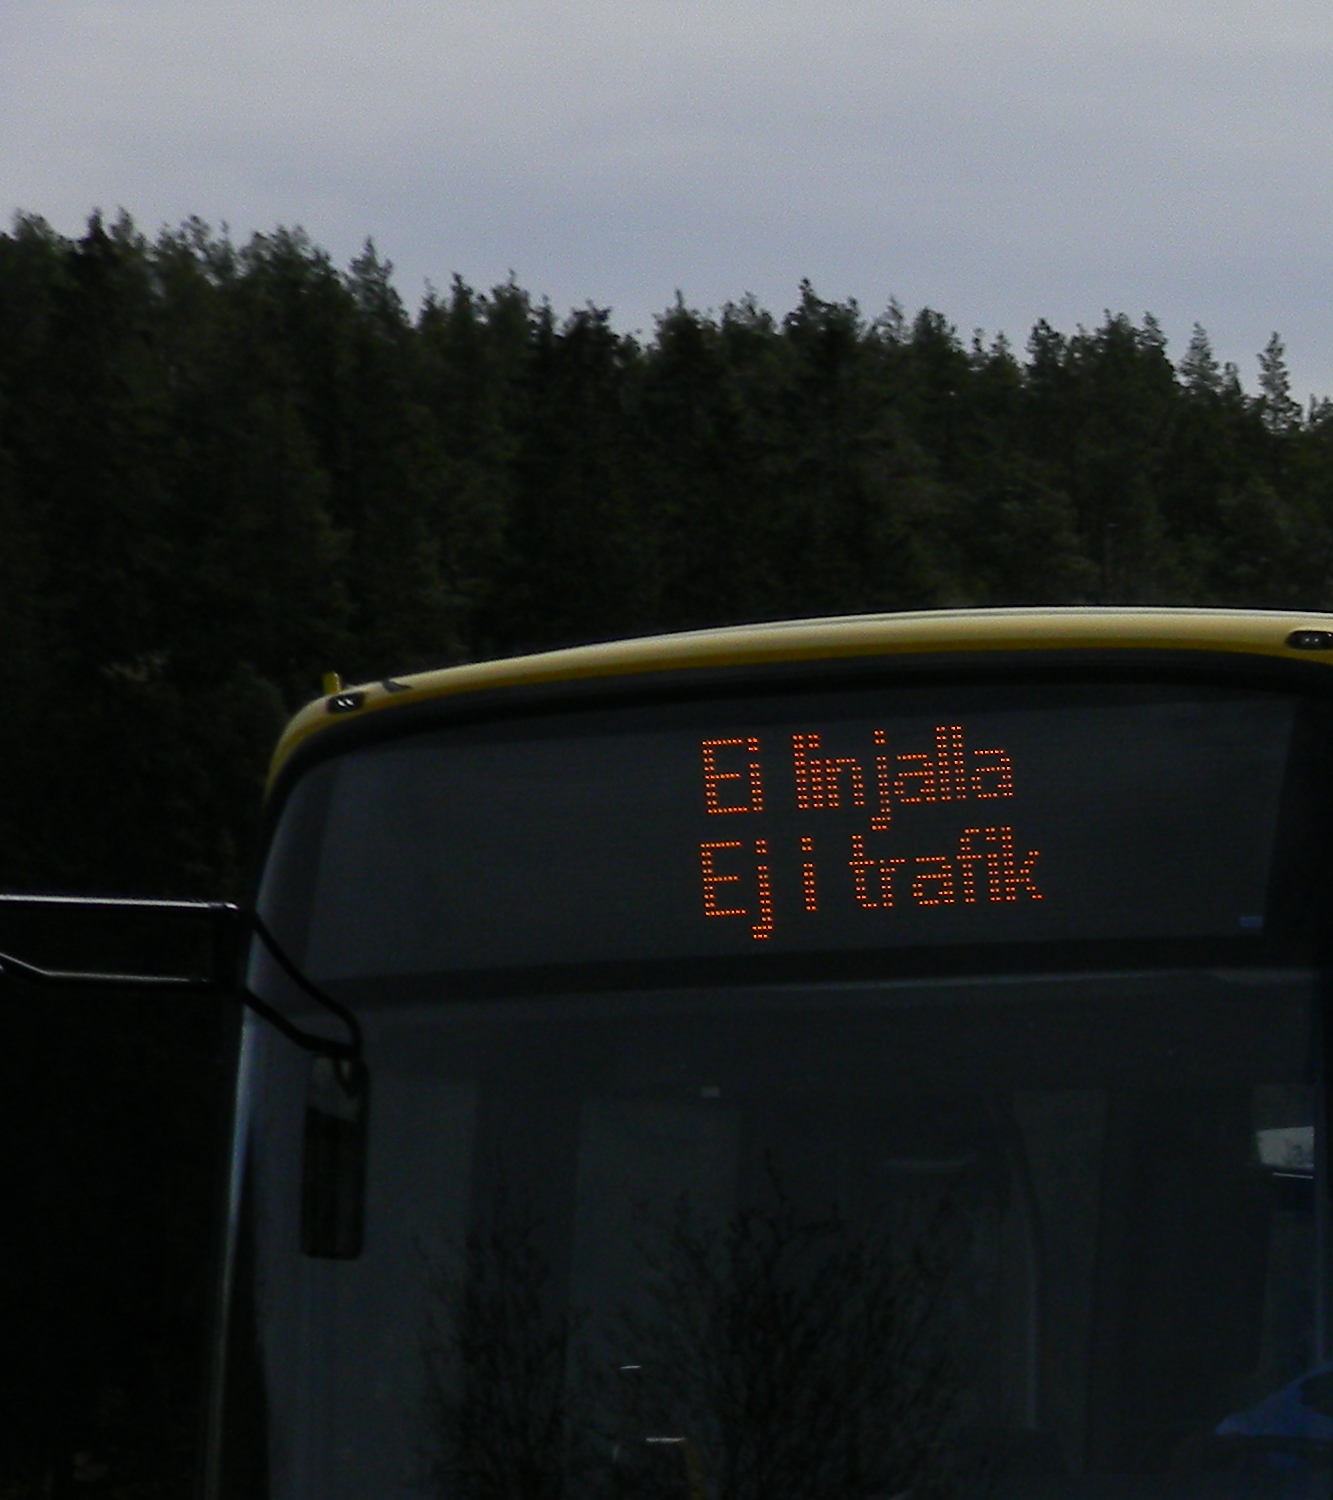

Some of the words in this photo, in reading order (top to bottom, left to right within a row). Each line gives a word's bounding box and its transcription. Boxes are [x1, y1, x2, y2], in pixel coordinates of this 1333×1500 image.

[701, 736, 763, 815] Ei
[791, 724, 1013, 831] linjalla
[699, 838, 773, 940] Ej
[800, 835, 818, 912] i
[847, 825, 1043, 908] trafik
